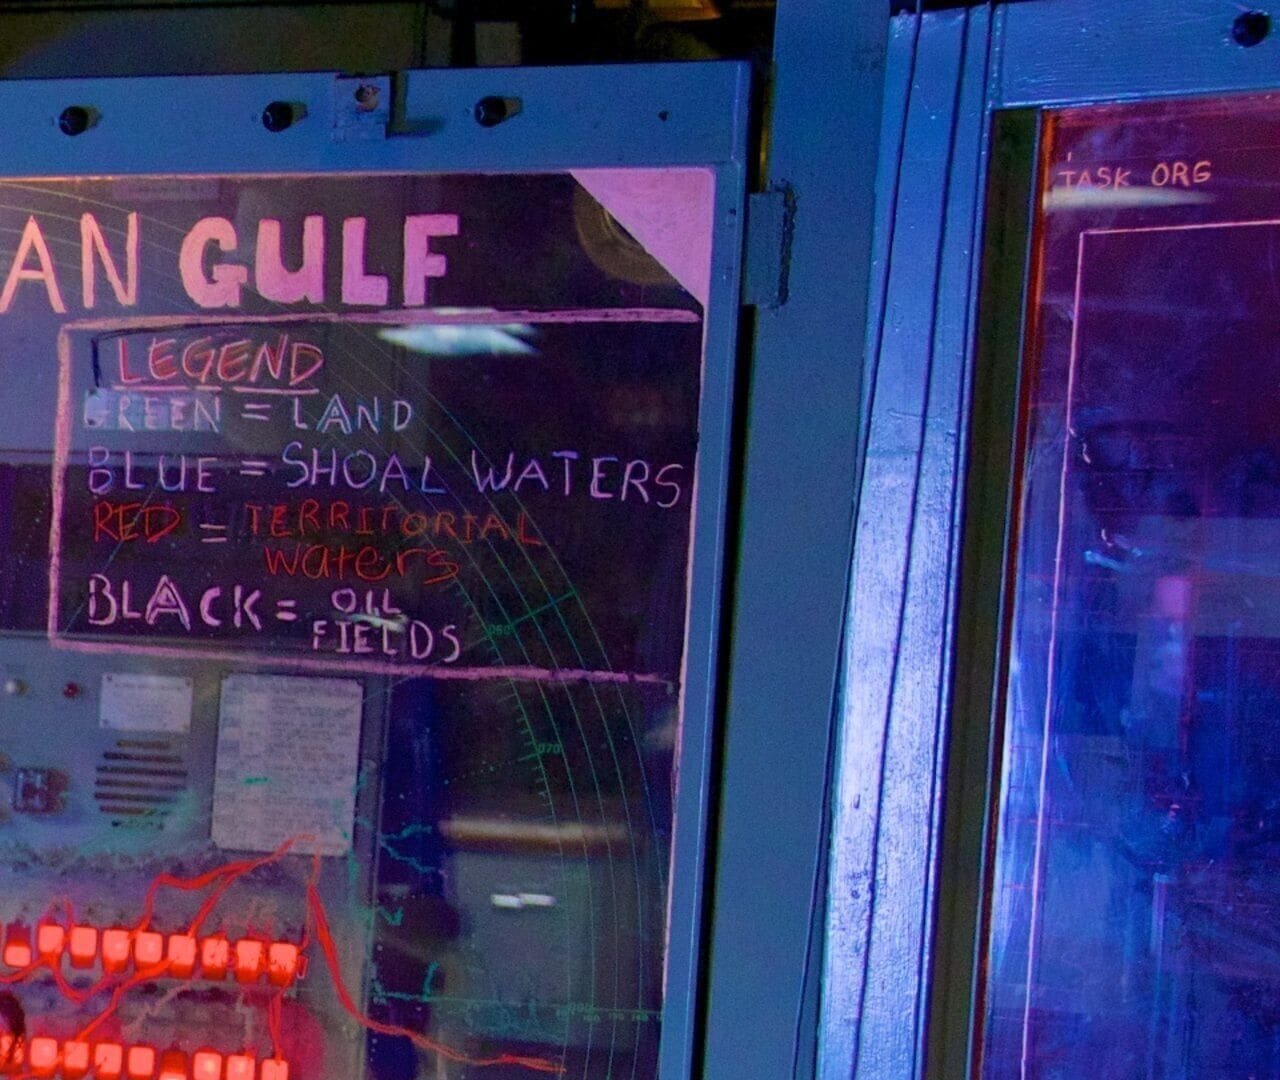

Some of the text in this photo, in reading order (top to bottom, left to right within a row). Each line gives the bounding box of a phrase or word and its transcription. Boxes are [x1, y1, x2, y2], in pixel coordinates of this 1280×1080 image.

[1058, 160, 1212, 190] TASK ORG
[178, 213, 460, 308] GULF
[118, 333, 324, 386] LEGEND
[84, 394, 221, 433] GREEN
[294, 394, 412, 434] LAND
[88, 446, 218, 495] BLUE
[282, 442, 446, 495] SHOAL
[471, 451, 684, 508] WATERS
[91, 503, 181, 545] RED
[245, 499, 542, 546] TERRITORIAL
[264, 544, 461, 584] waters
[87, 574, 263, 633] BLACK
[331, 587, 402, 617] OIL
[312, 615, 462, 664] FIELDS
